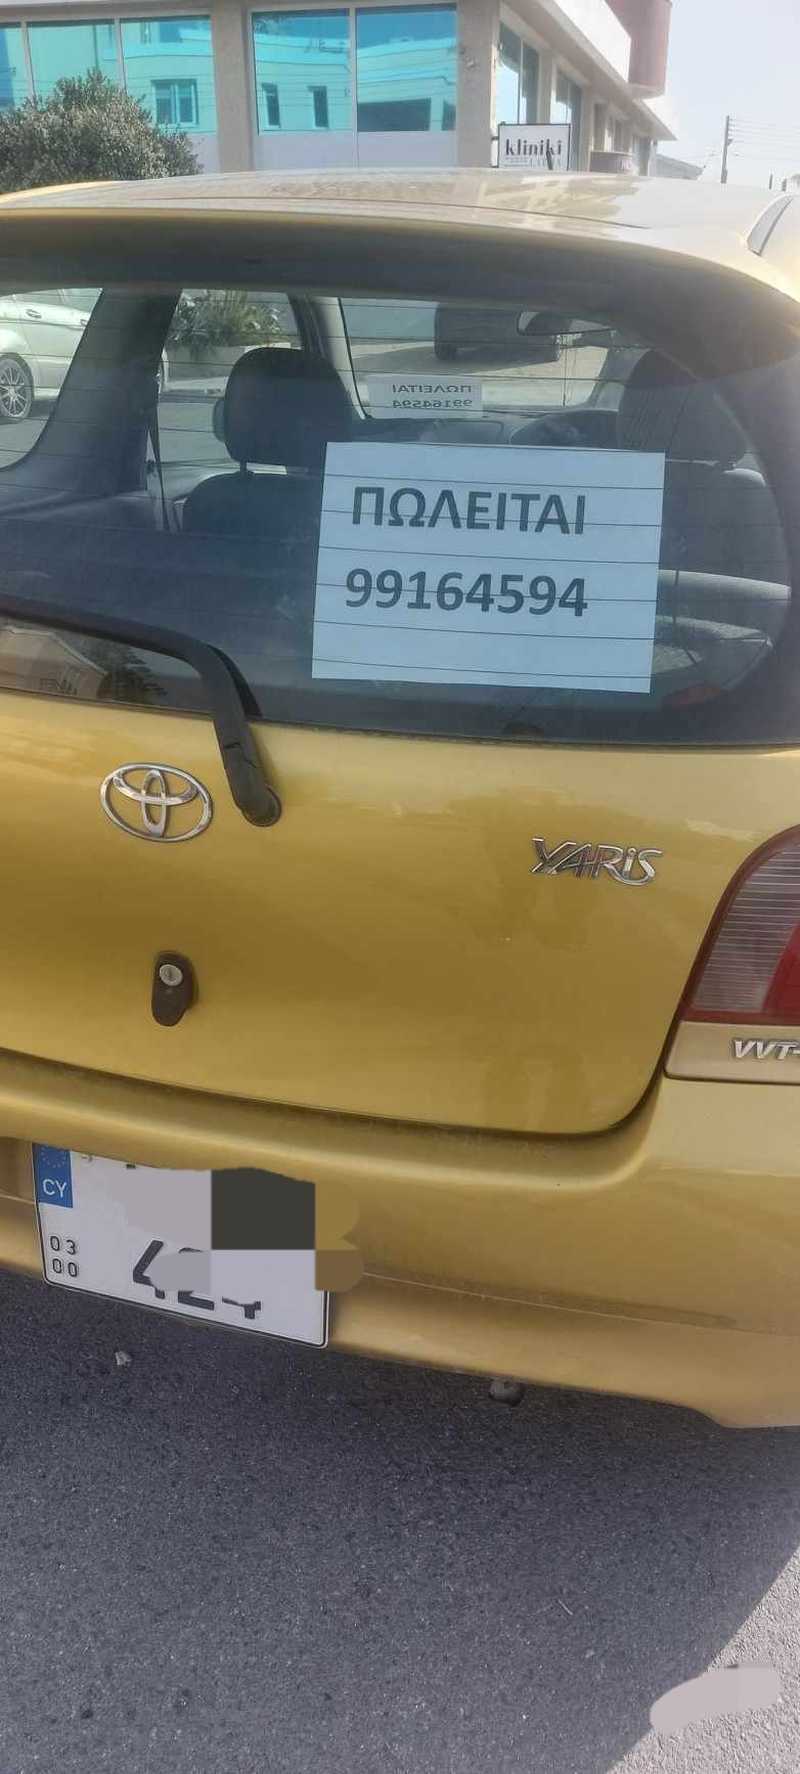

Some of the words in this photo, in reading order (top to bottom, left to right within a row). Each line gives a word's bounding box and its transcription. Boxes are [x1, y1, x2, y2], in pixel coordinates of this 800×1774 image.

[505, 138, 562, 156] kliniki
[352, 486, 586, 535] ΠΩΛΕΙΤΑΙ
[345, 568, 588, 617] 99164594
[42, 1178, 68, 1198] CY
